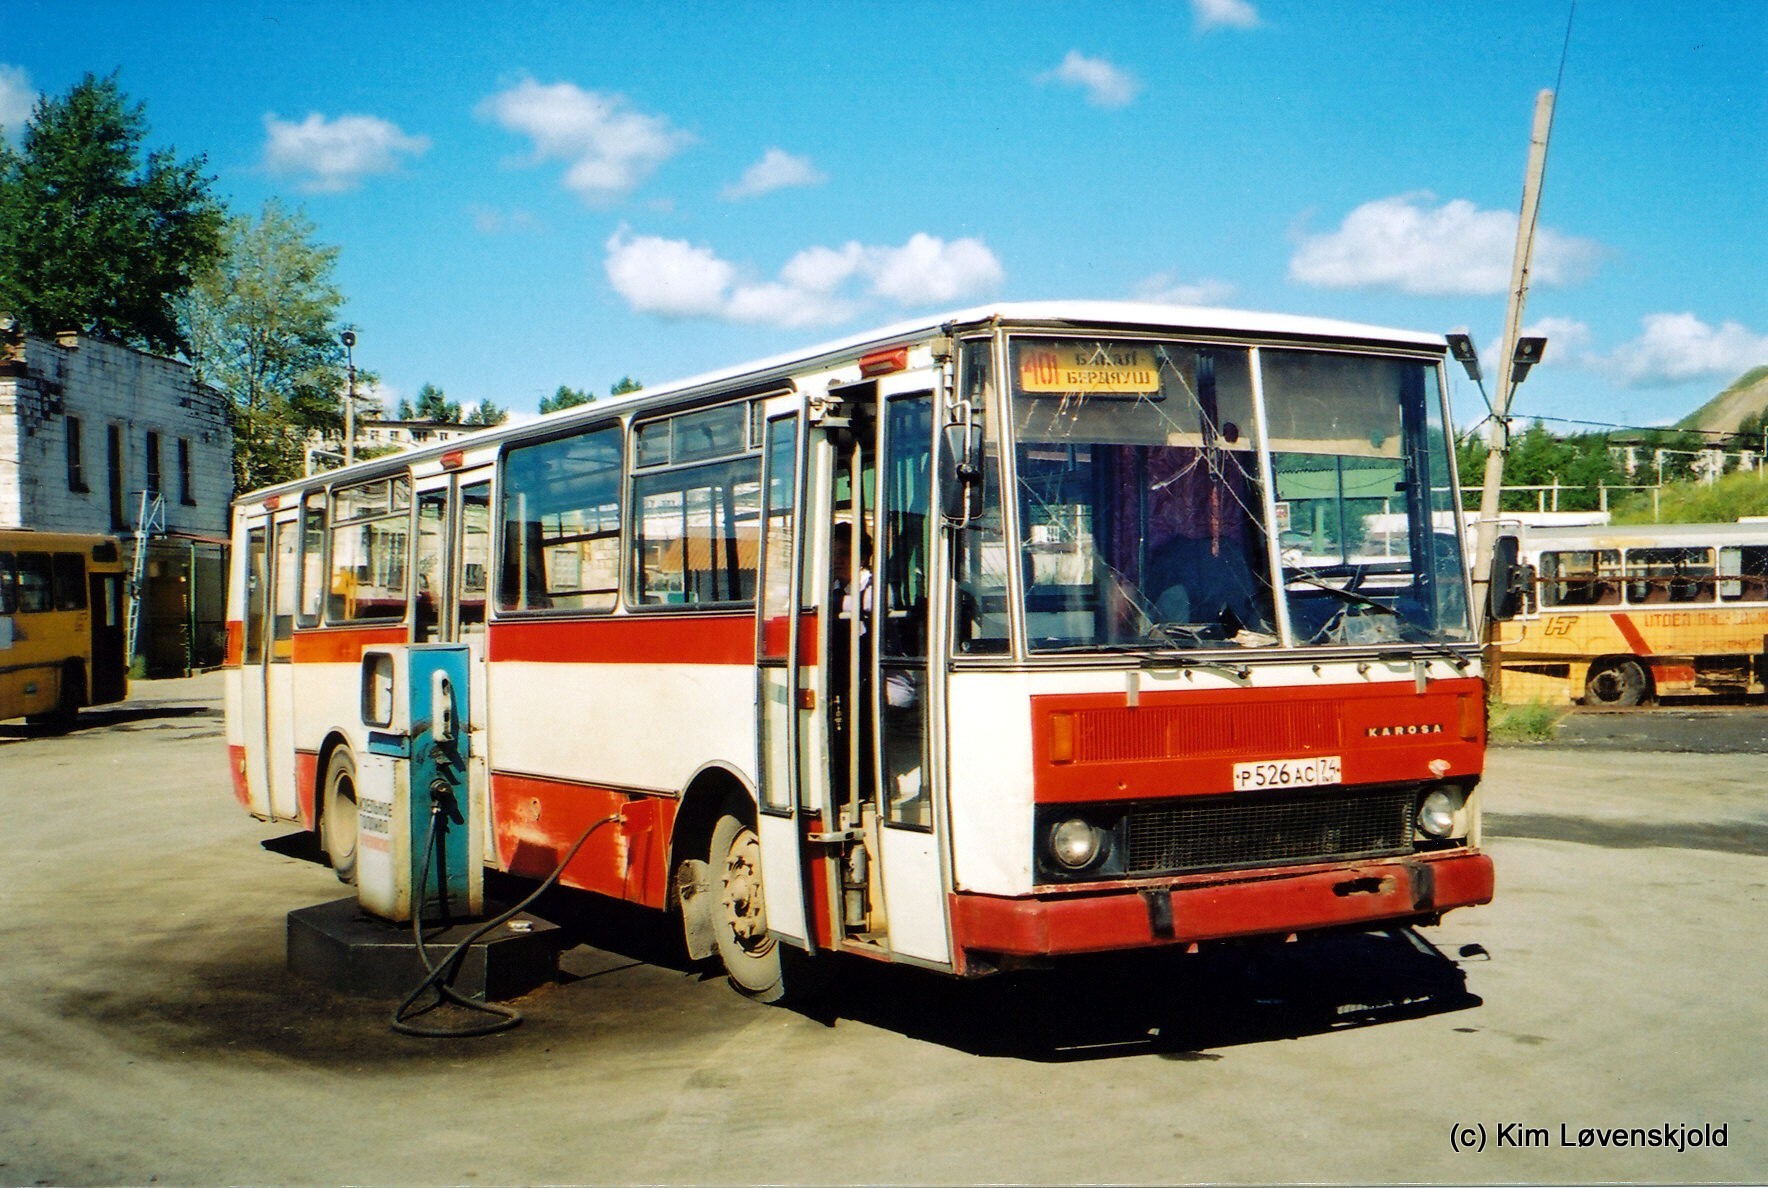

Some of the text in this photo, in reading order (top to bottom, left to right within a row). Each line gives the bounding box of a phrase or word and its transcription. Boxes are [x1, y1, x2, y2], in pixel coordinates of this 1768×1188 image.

[1023, 351, 1059, 385] 401
[1066, 371, 1151, 384] БЕРДЯУШ
[1368, 724, 1441, 737] KAROSA
